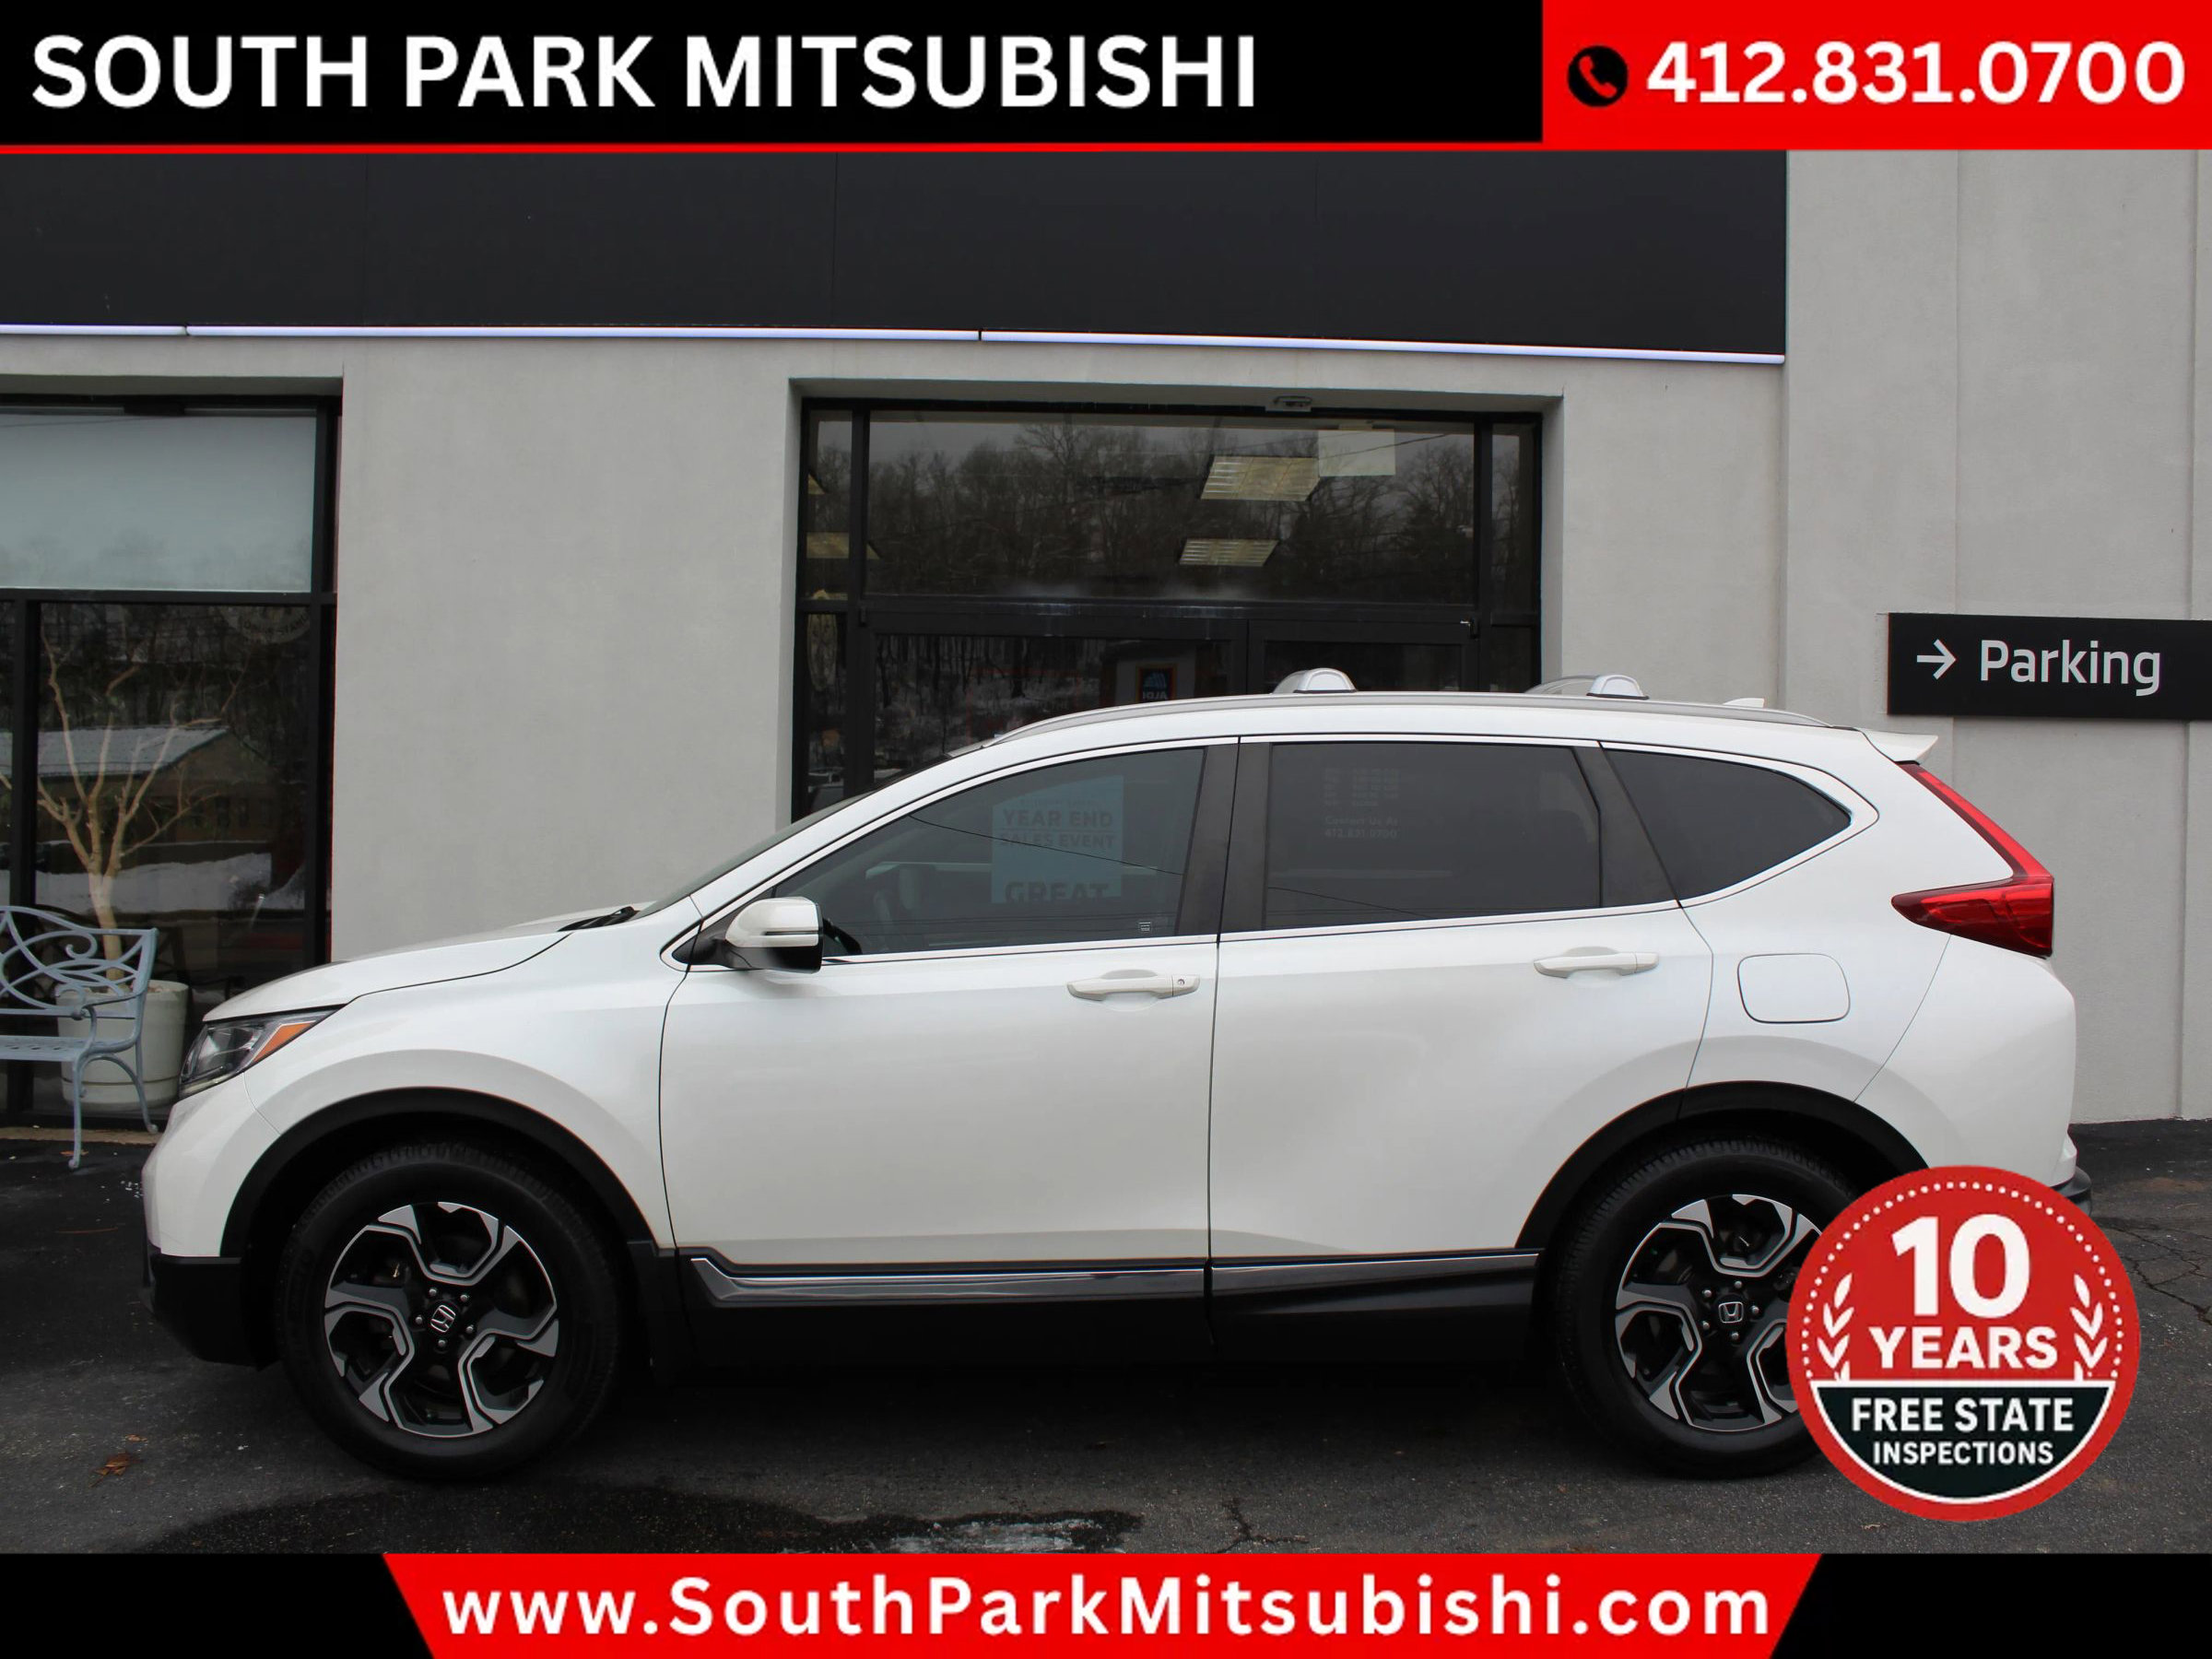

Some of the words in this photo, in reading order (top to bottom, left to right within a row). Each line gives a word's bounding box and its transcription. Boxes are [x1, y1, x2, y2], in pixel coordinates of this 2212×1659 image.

[1981, 638, 2161, 697] Parking
[1003, 808, 1061, 827] YEAR
[1069, 810, 1113, 828] END
[1059, 834, 1115, 848] EVENT
[1005, 881, 1109, 903] GREAT
